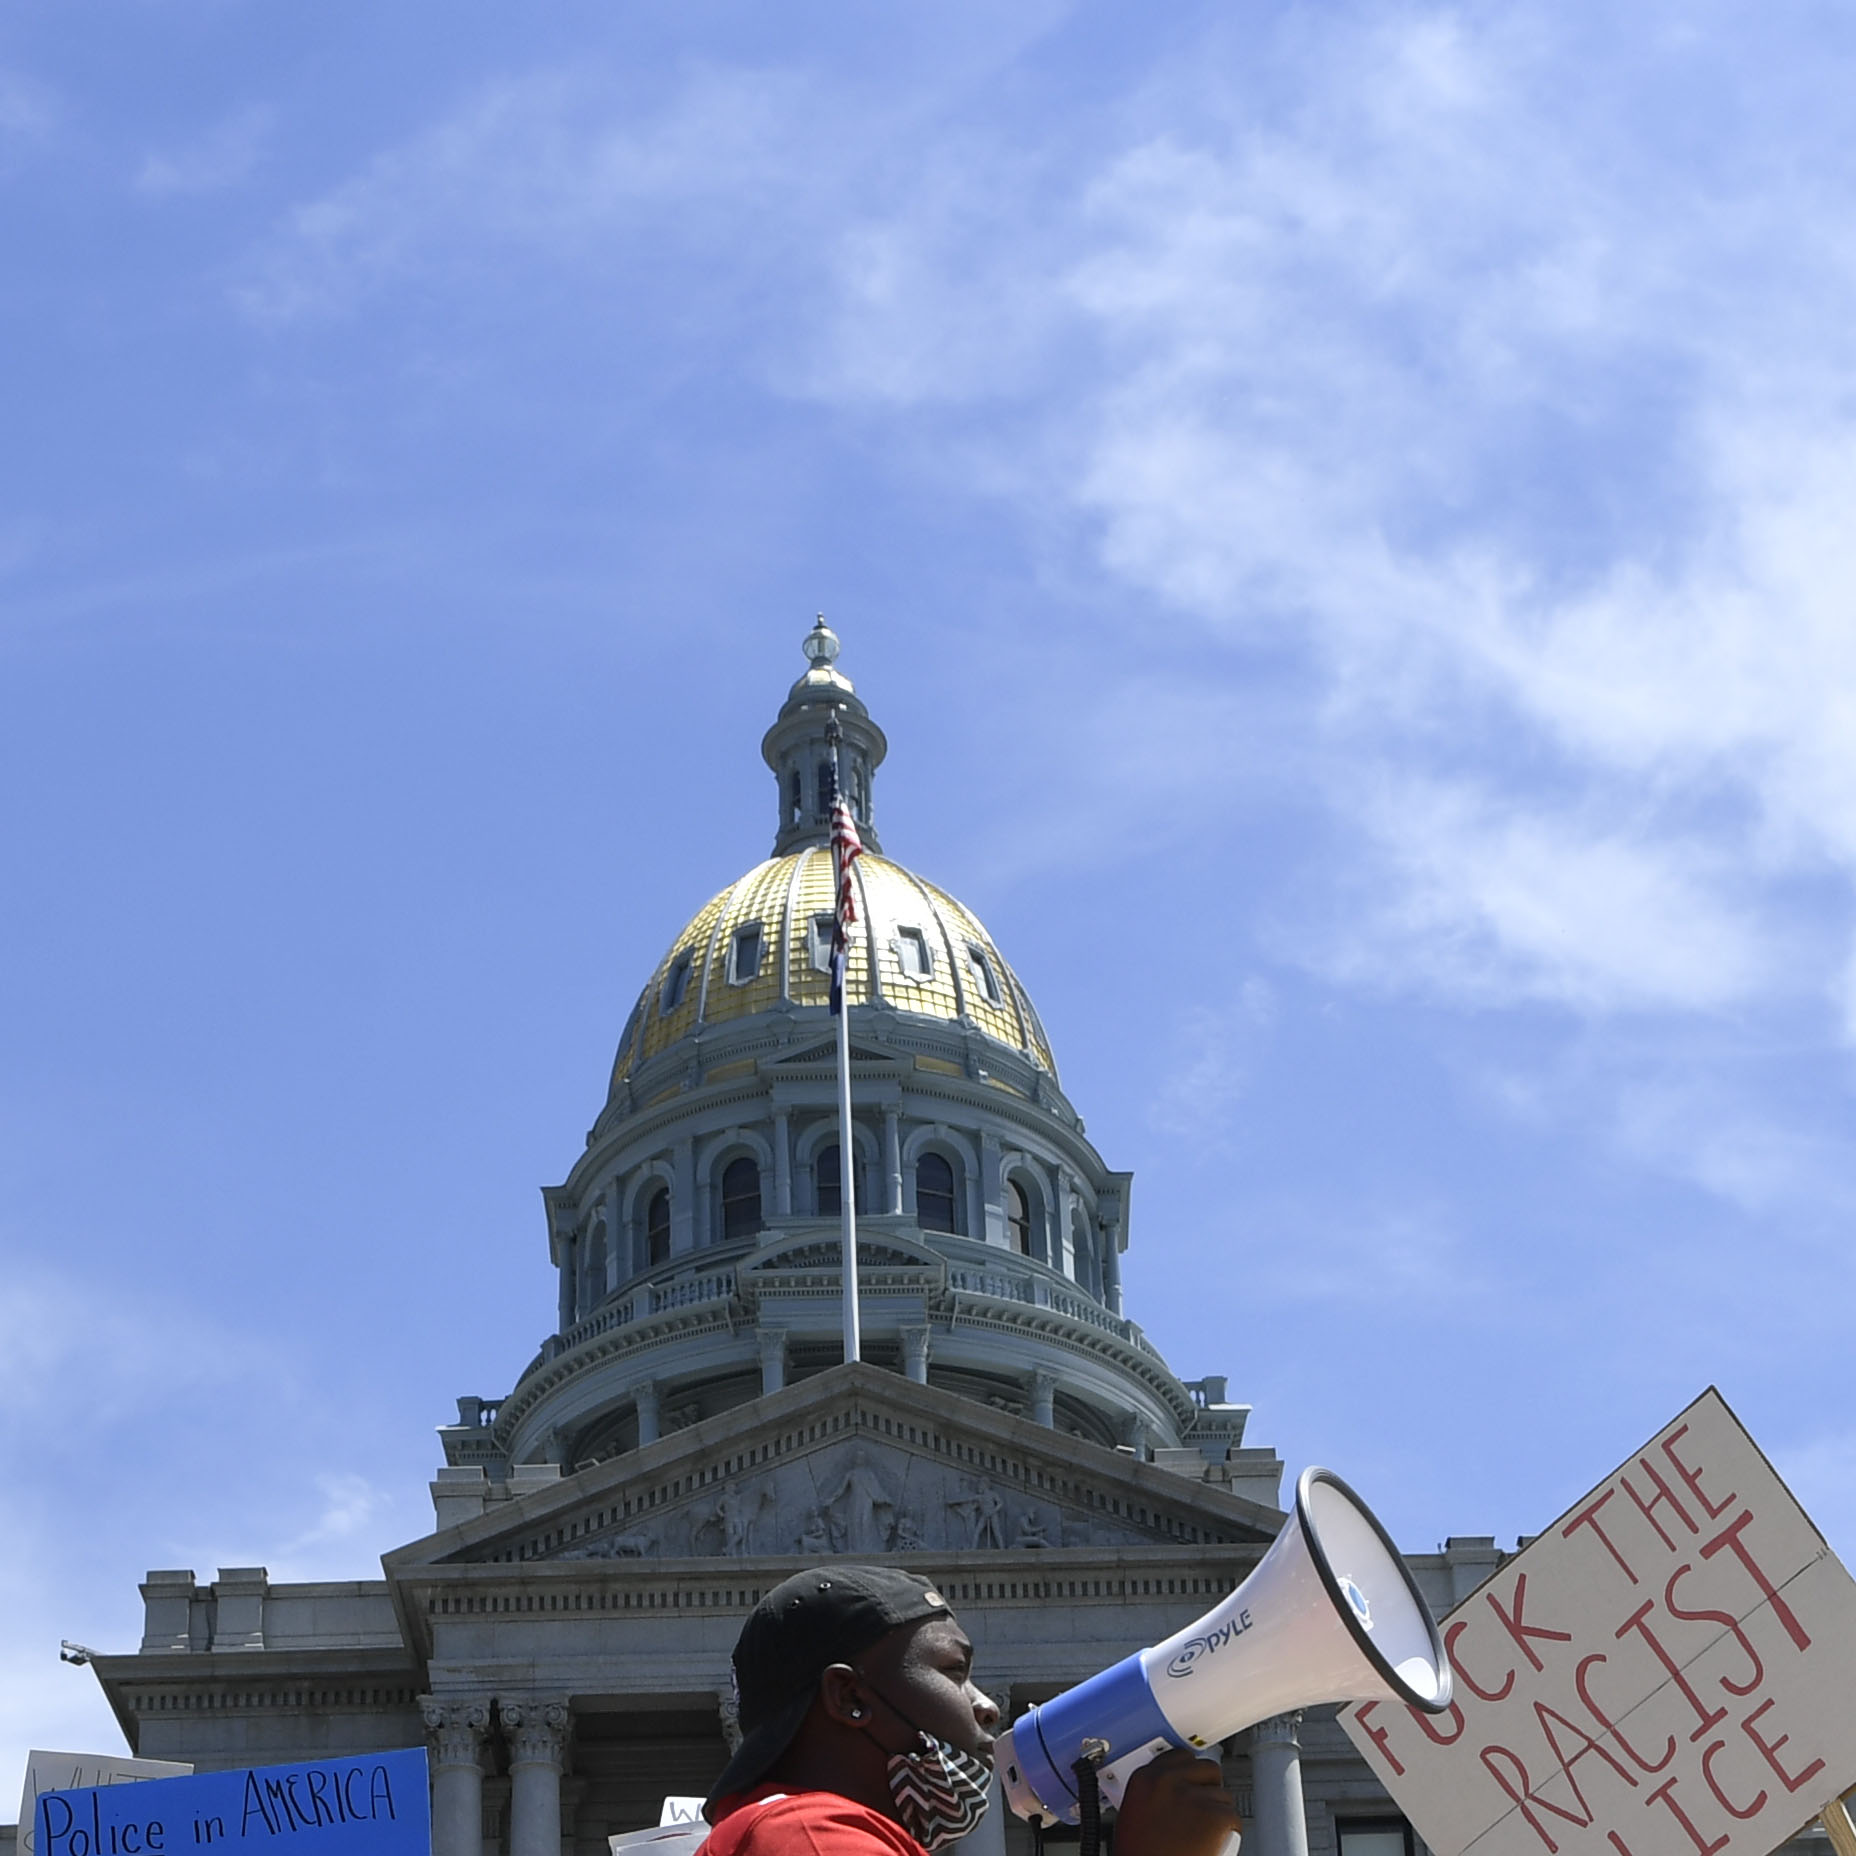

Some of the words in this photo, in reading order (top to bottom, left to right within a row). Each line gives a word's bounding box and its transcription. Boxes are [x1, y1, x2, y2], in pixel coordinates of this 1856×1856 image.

[1561, 1423, 1737, 1586] THE
[1479, 1509, 1811, 1853] RACIST
[193, 1809, 224, 1845] in
[242, 1764, 396, 1836] AMERICA
